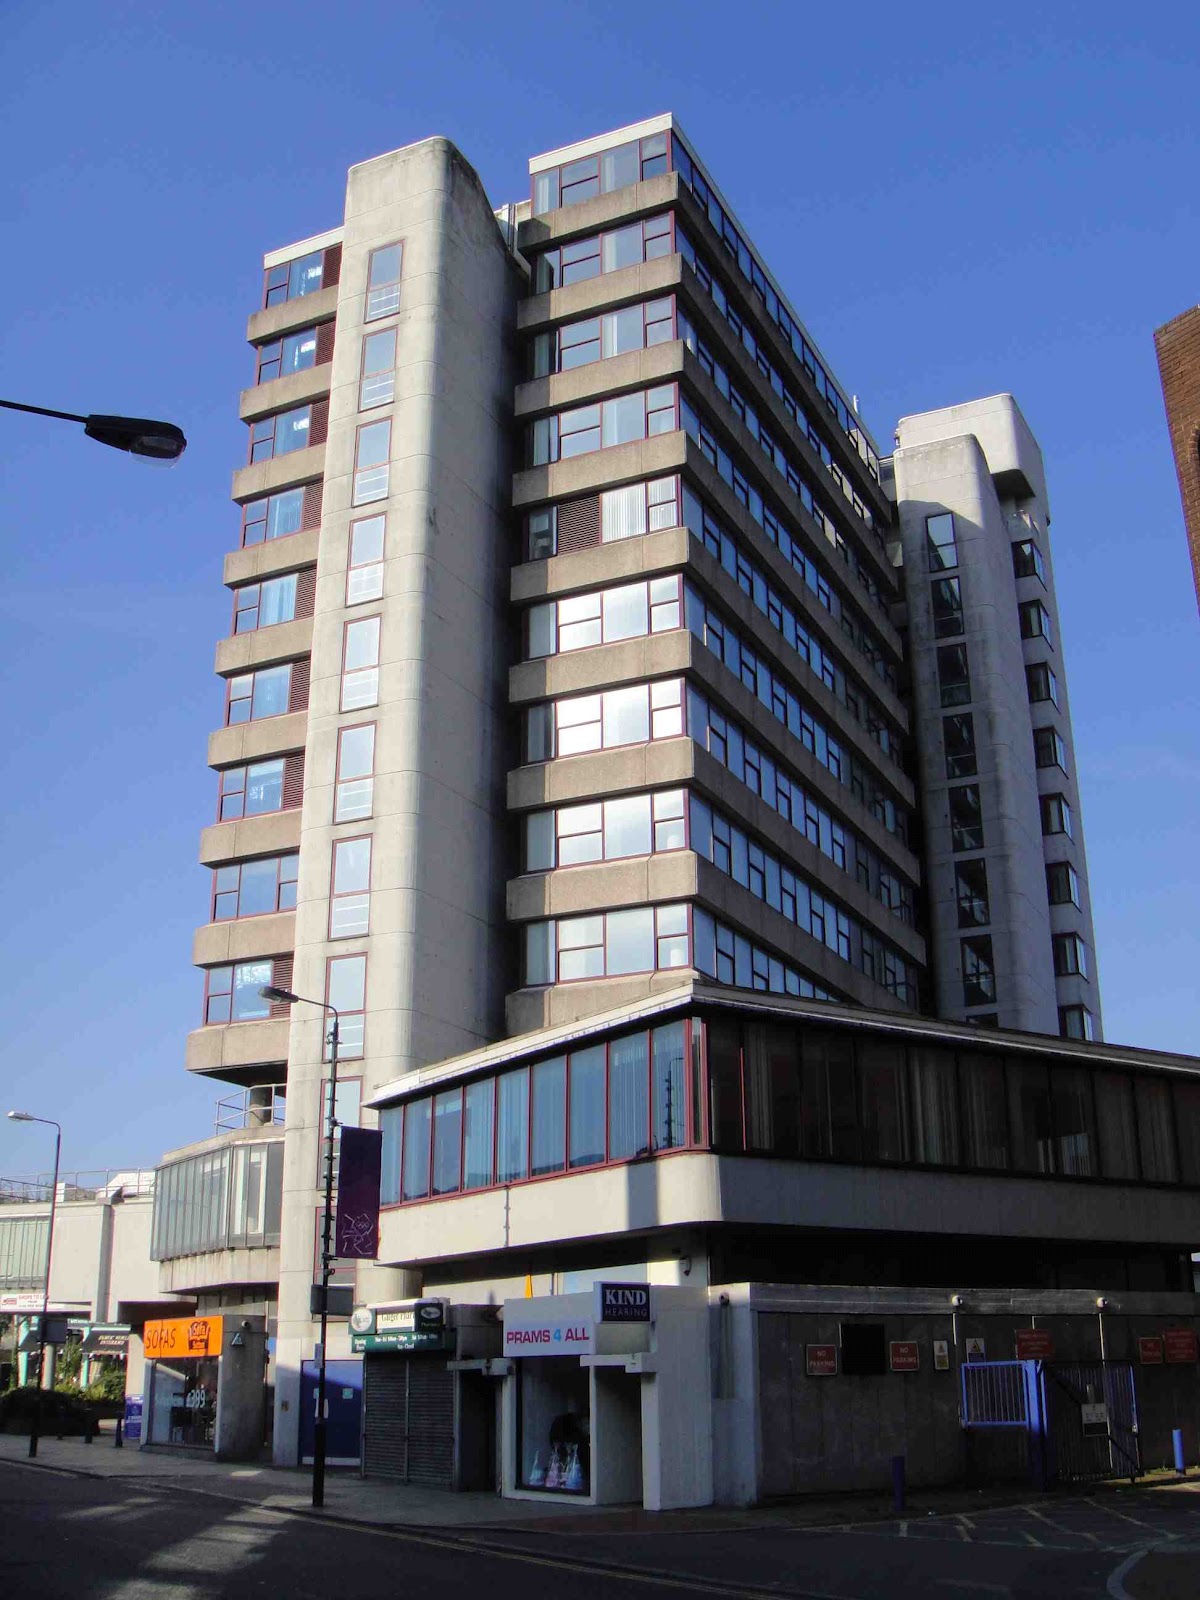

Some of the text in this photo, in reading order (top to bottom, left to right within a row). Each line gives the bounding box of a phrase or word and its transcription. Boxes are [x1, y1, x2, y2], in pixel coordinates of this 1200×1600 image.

[605, 1289, 647, 1306] KIND
[604, 1307, 648, 1317] HEARING
[146, 1328, 176, 1349] SOFAS
[506, 1327, 590, 1344] PRAMS 4 ALL
